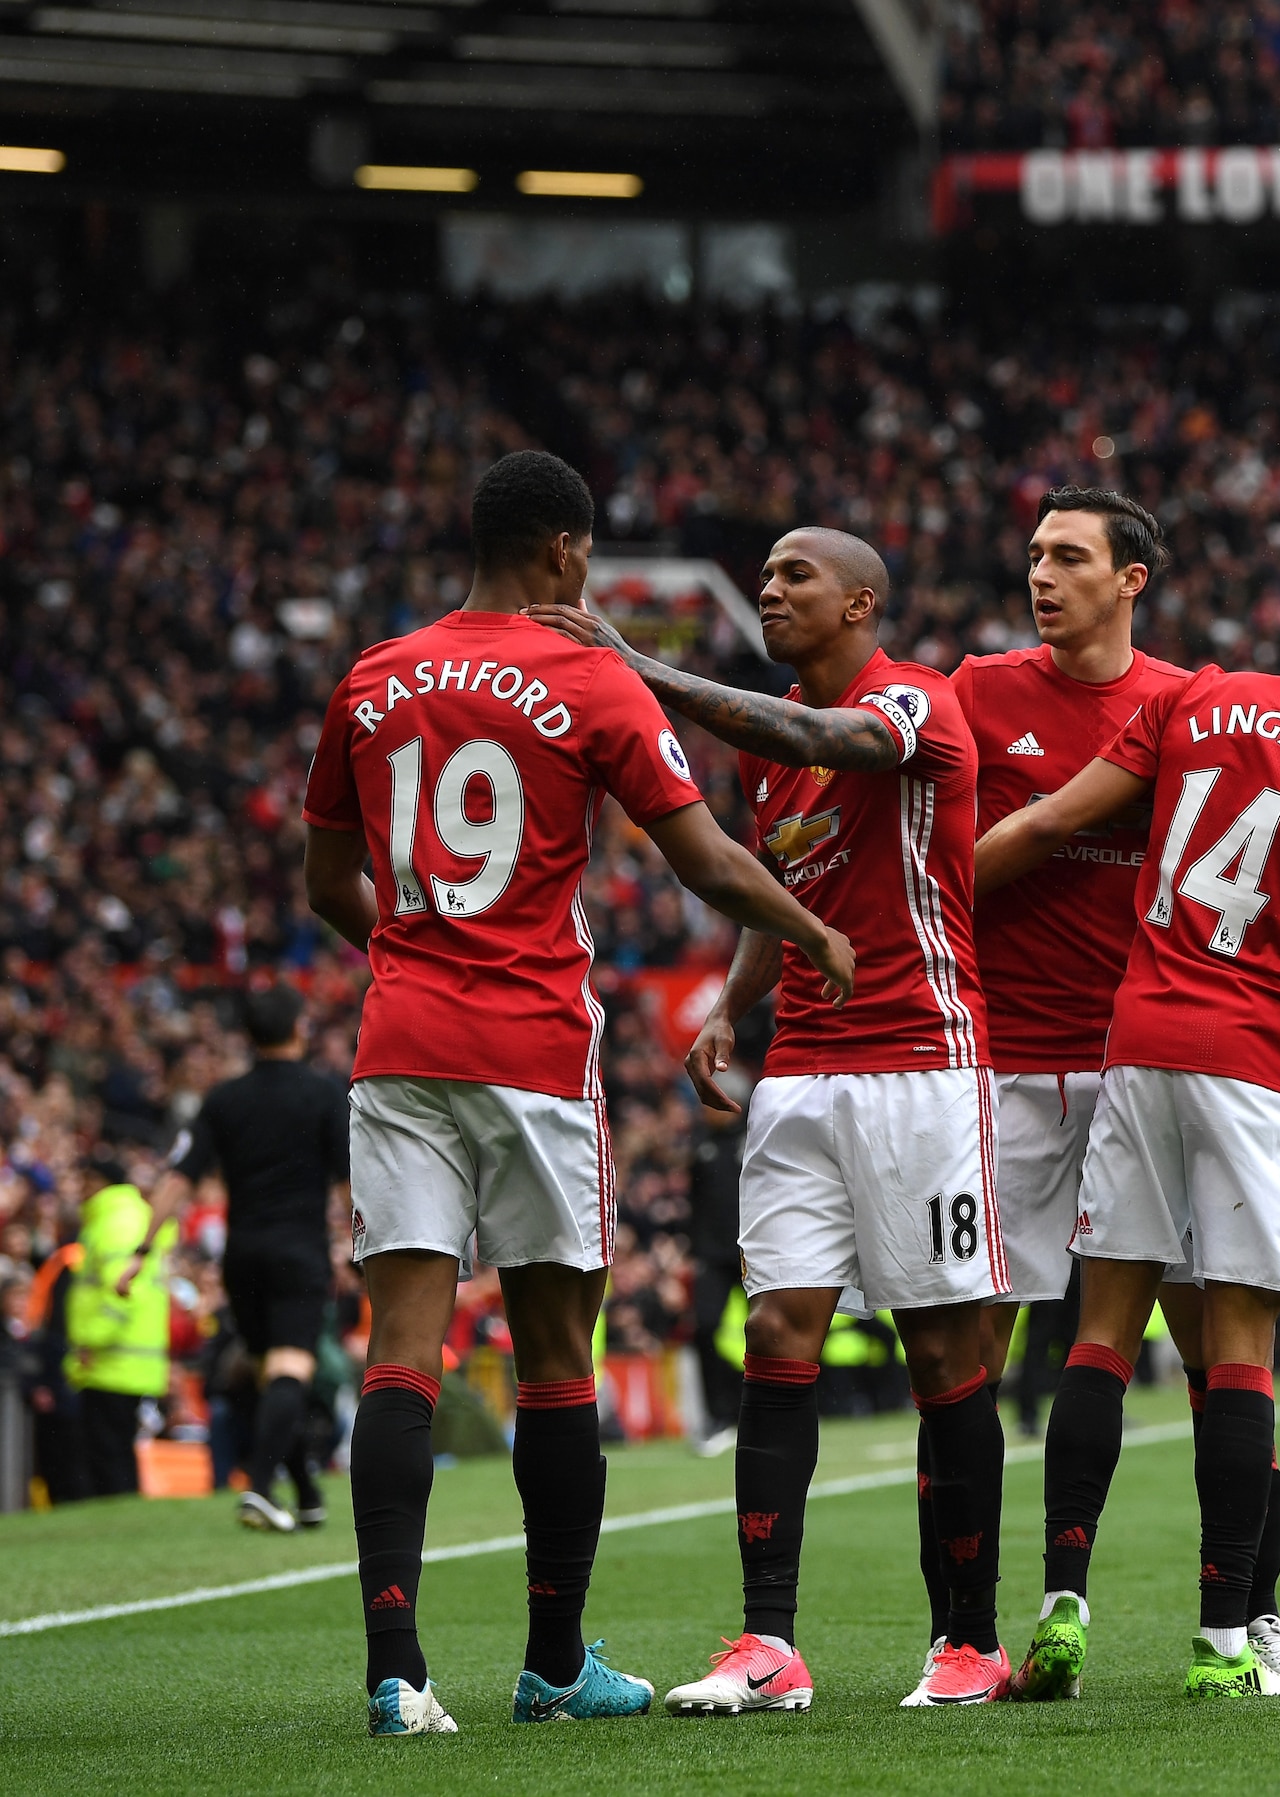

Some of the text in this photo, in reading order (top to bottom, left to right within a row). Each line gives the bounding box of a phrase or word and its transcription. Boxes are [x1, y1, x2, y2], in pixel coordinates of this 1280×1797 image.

[1021, 148, 1161, 225] ONE
[354, 660, 573, 738] RASHFORD
[882, 702, 916, 759] Captain
[1006, 746, 1045, 757] adidas
[386, 736, 525, 918] 19
[926, 1191, 981, 1265] 18
[370, 1599, 411, 1610] adidas
